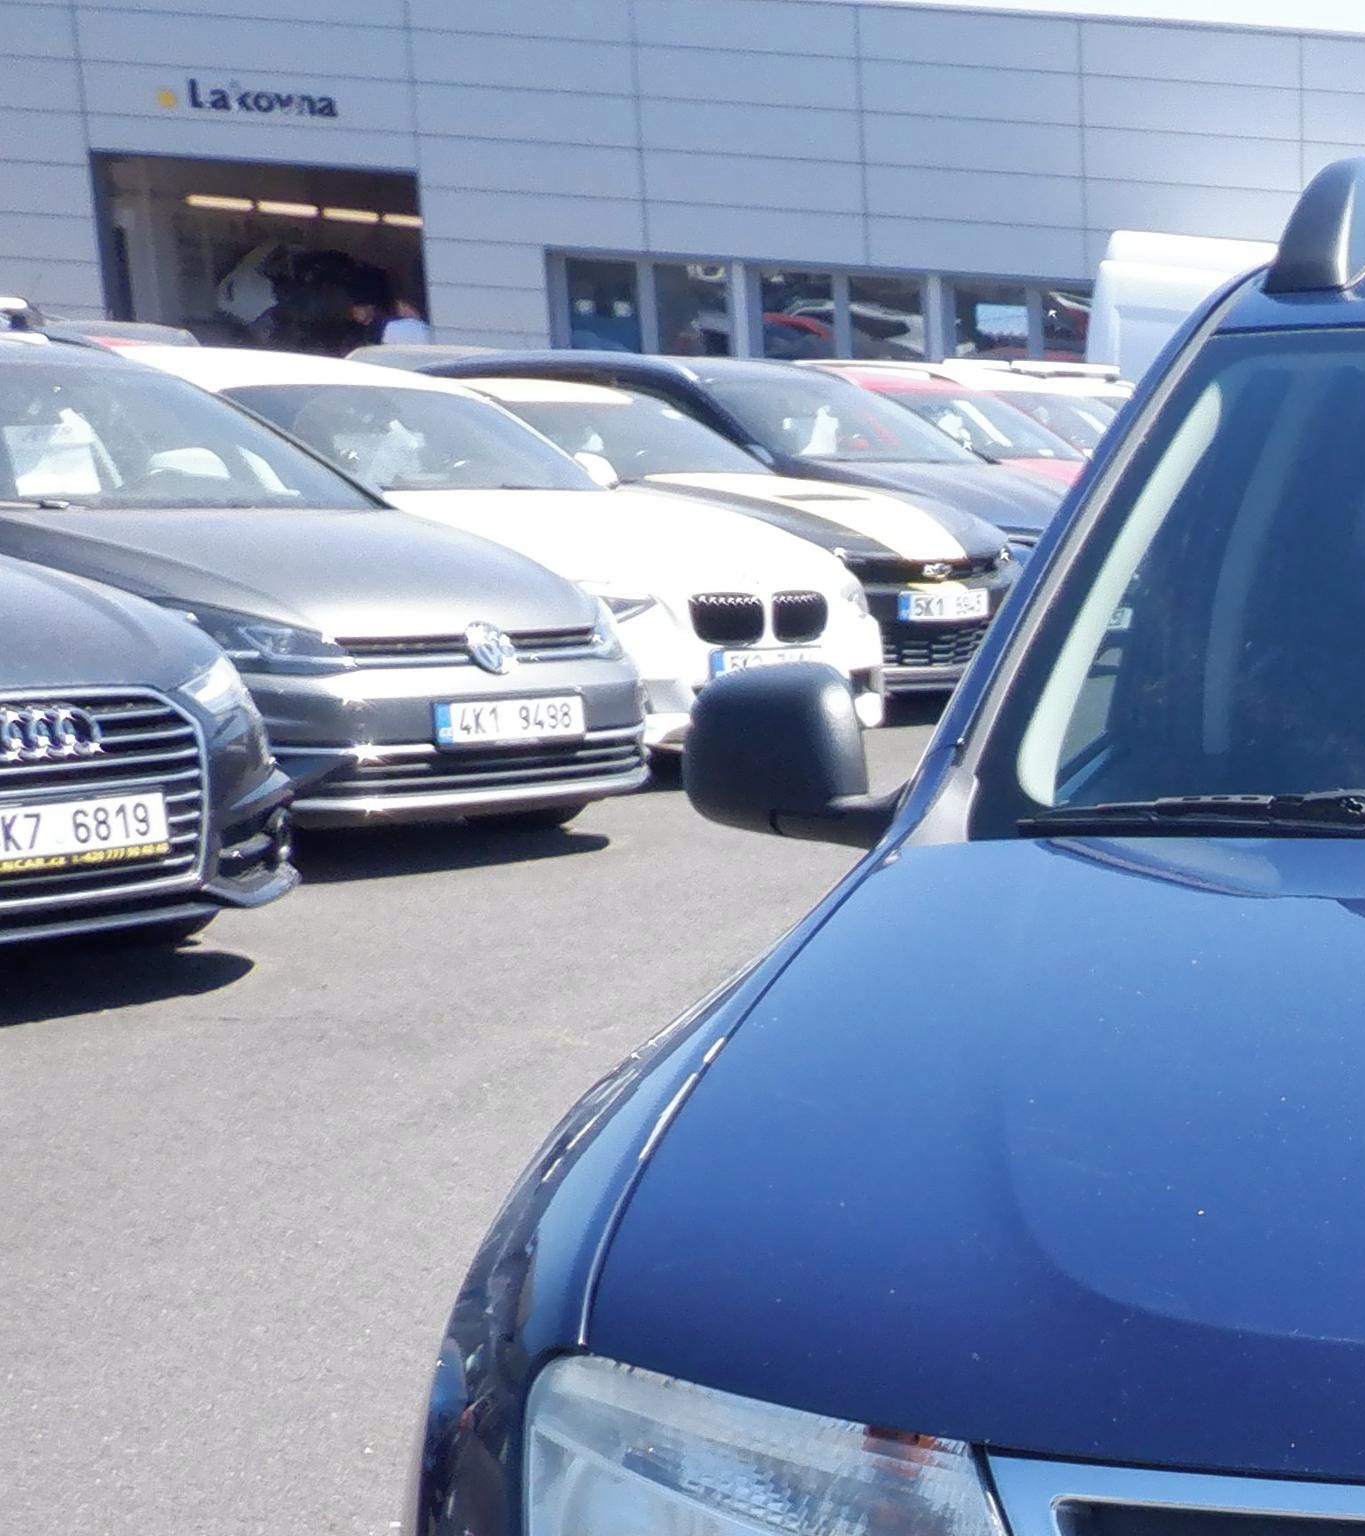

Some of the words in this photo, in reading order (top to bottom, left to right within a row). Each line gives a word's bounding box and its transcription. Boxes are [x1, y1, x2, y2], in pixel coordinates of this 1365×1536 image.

[187, 78, 339, 117] Lakovna
[459, 706, 500, 735] 4K1
[518, 702, 572, 730] 9498
[0, 812, 41, 851] K7
[72, 802, 150, 844] 6819
